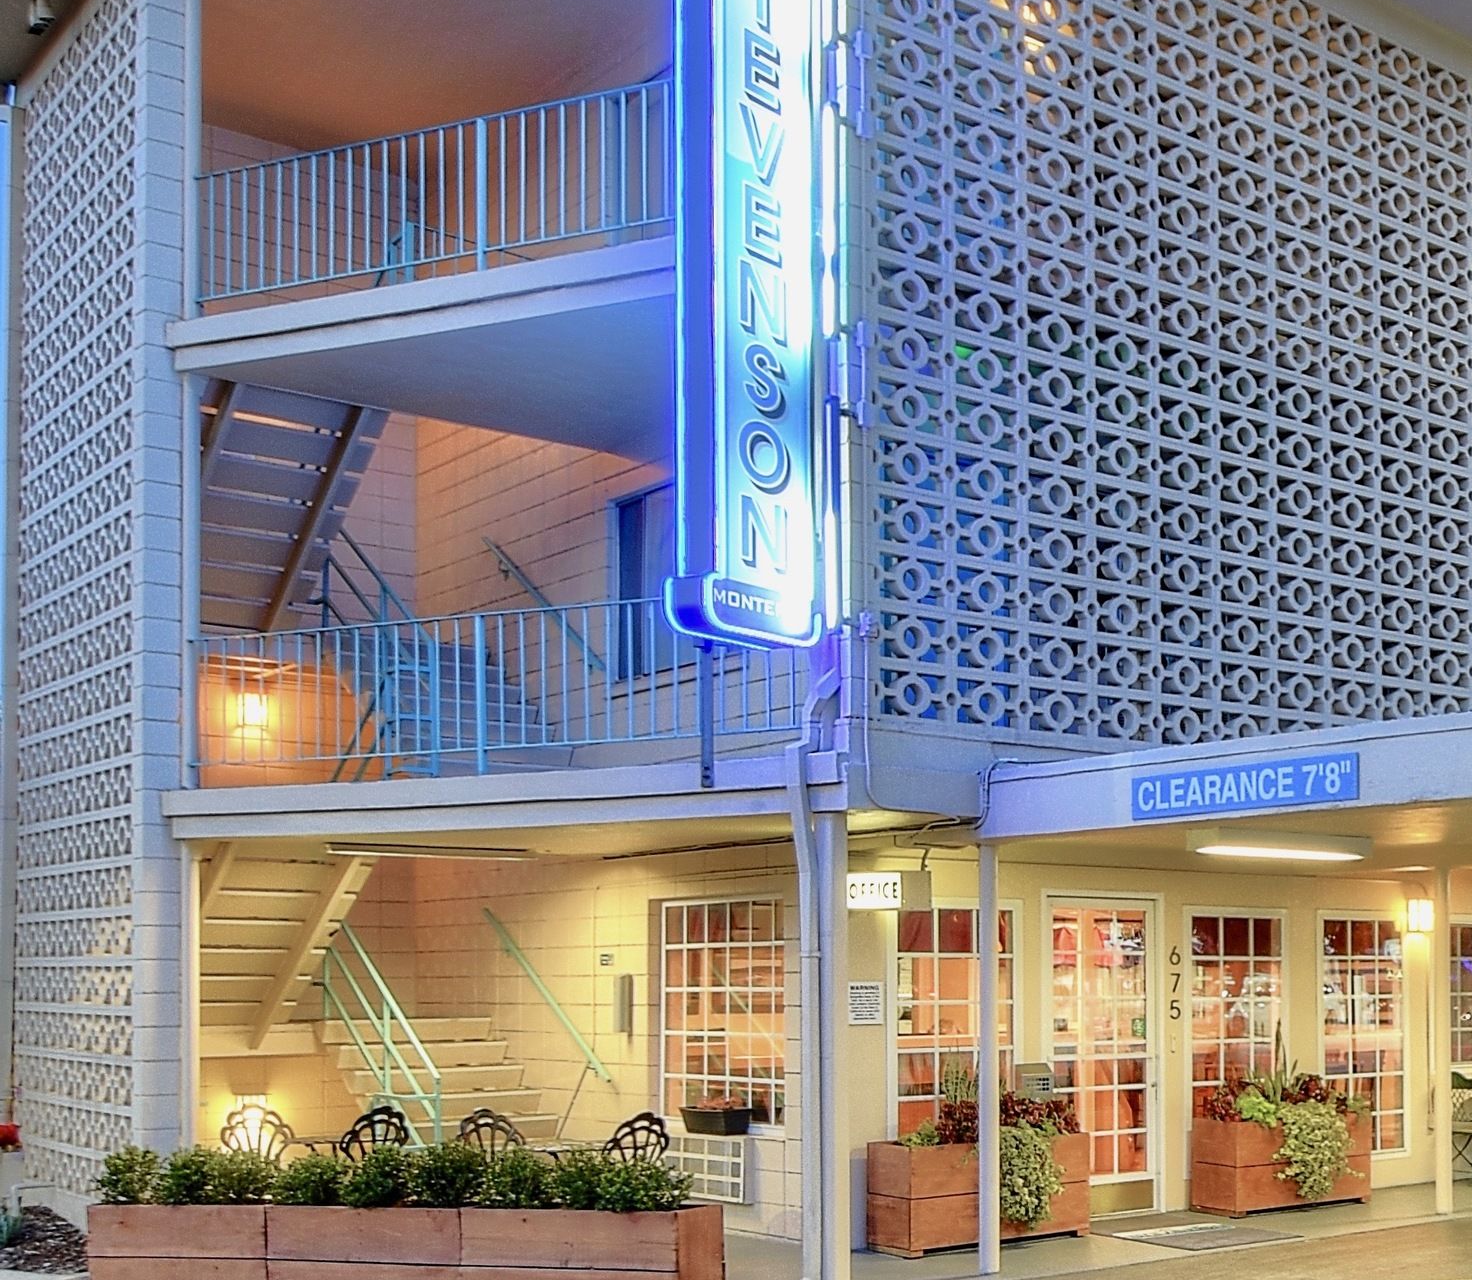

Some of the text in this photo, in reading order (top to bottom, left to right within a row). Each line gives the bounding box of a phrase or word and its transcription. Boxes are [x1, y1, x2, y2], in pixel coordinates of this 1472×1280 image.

[713, 587, 776, 616] MONTE
[1138, 760, 1351, 811] CLEARANCE 7'8"
[849, 882, 898, 899] OFFICE
[1169, 945, 1181, 1020] 675
